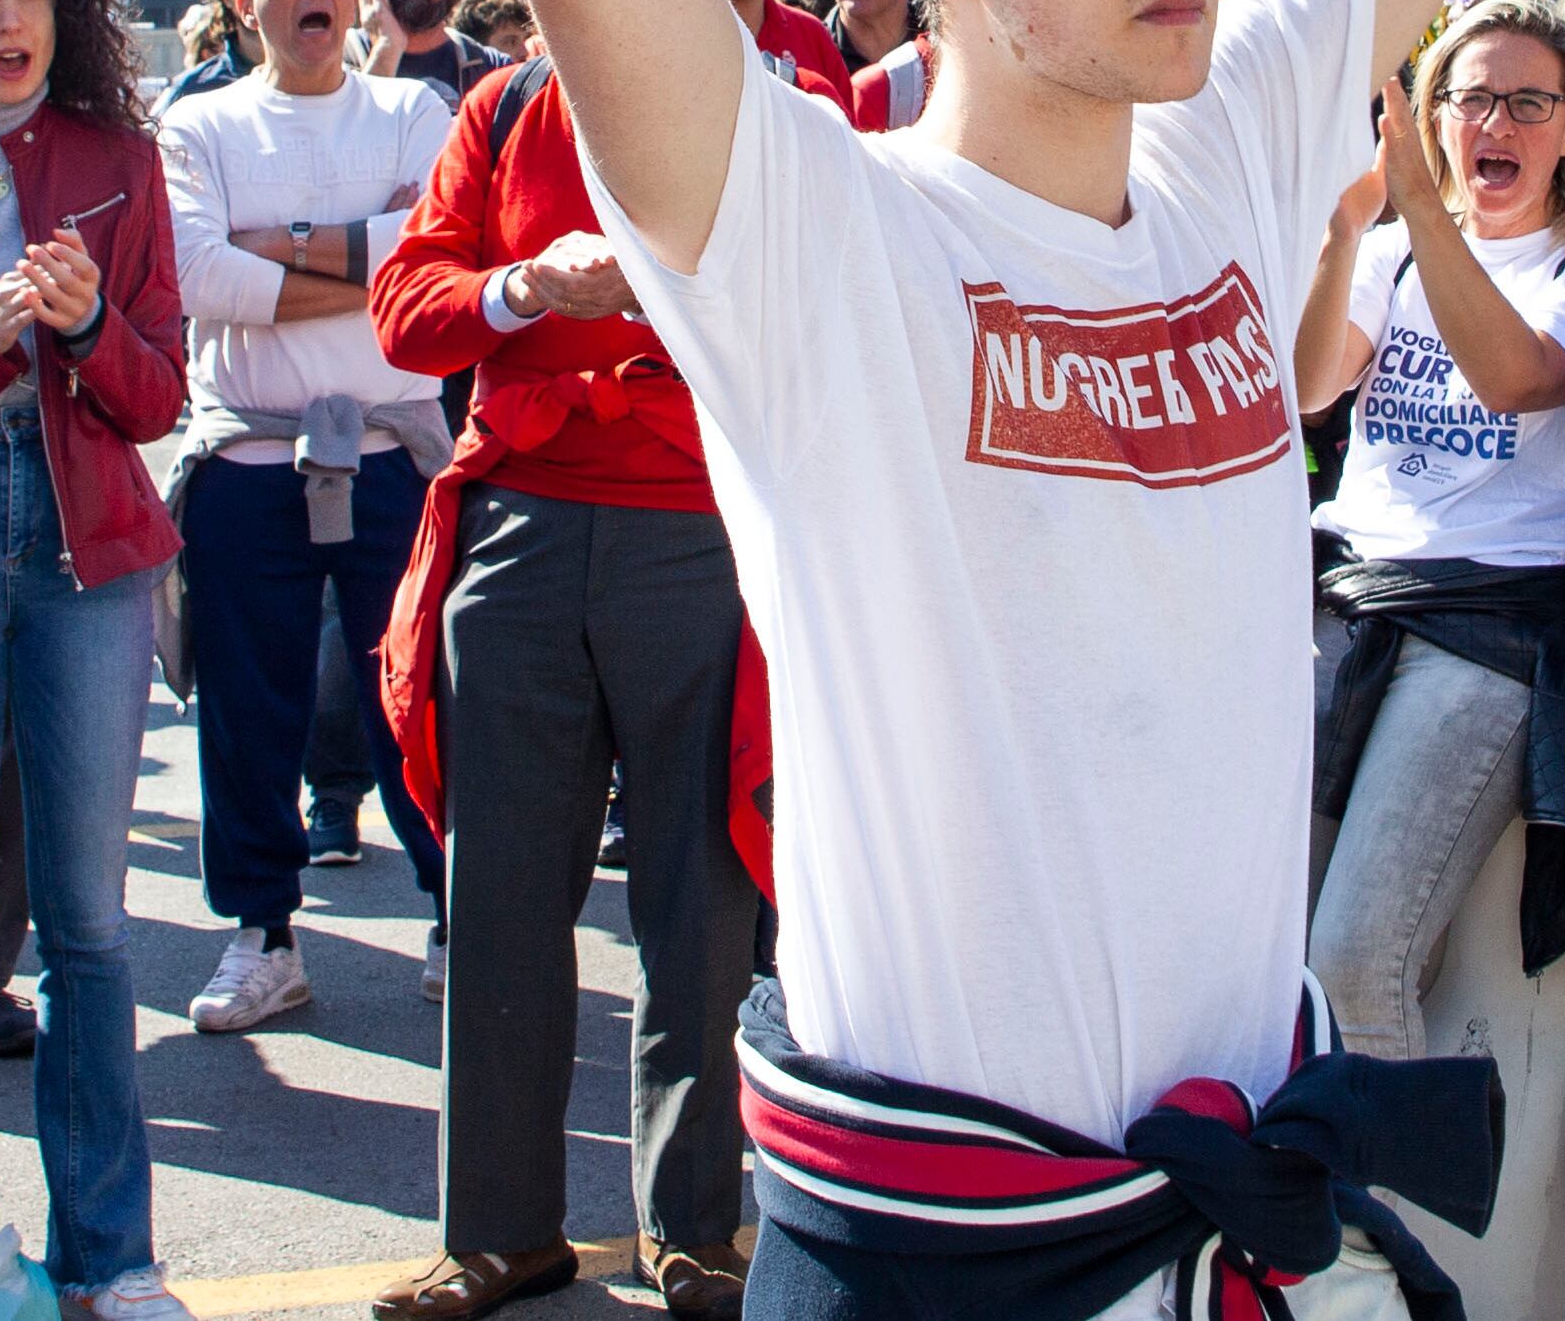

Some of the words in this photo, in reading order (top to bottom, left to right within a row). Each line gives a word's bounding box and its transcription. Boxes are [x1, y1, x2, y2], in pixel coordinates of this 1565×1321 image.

[1378, 344, 1453, 385] CUR
[1371, 377, 1408, 395] CON
[1411, 385, 1434, 400] LA
[1365, 396, 1518, 427] DOMICILIARE
[1366, 420, 1517, 460] PRECOCE
